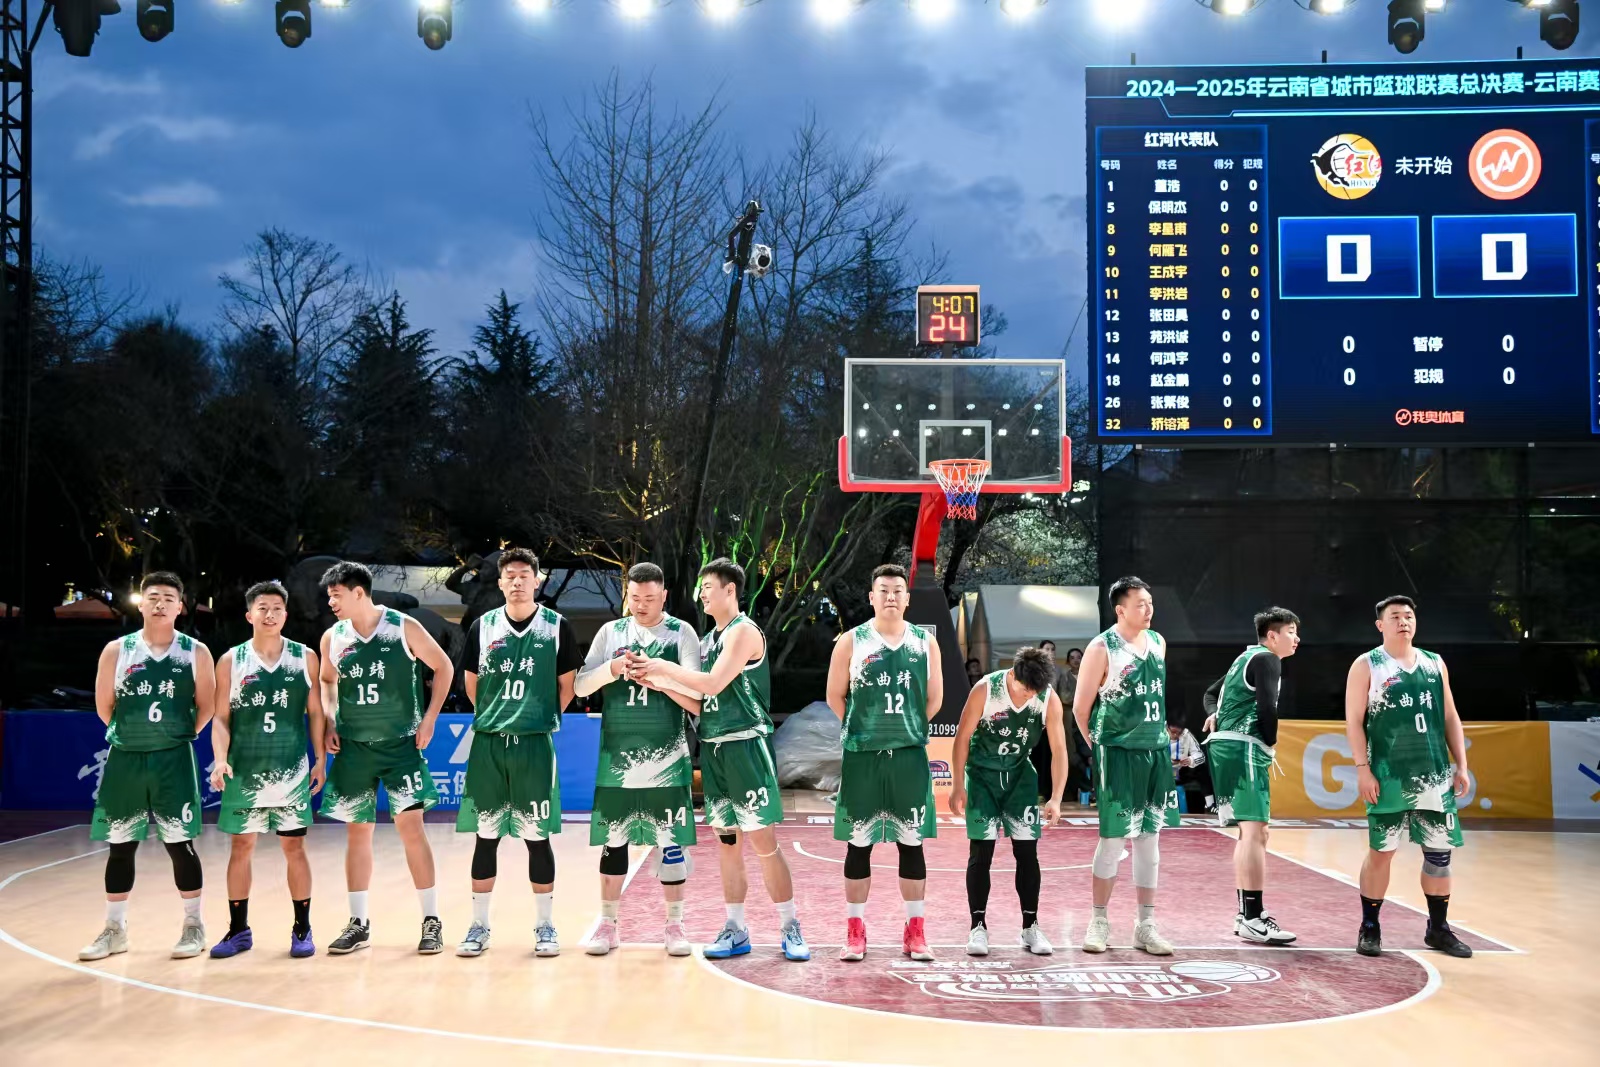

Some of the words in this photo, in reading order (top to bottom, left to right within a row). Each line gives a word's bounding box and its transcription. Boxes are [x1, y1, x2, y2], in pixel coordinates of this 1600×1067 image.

[1145, 132, 1218, 147] 红河代表队
[1101, 160, 1120, 170] 号码
[1157, 160, 1177, 169] 姓名
[1214, 159, 1234, 169] 得分
[1243, 159, 1263, 169] 犯规
[1396, 156, 1452, 175] 未开始
[1108, 181, 1113, 191] 1
[1220, 180, 1228, 190] 0
[1249, 180, 1257, 190] 0
[1107, 202, 1114, 213] 5
[1149, 201, 1186, 213] 保明杰
[1221, 201, 1228, 212] 0
[1250, 201, 1257, 212] 0
[1107, 224, 1115, 234] 8
[1221, 223, 1229, 233] 0
[1250, 223, 1258, 233] 0
[1108, 245, 1115, 256] 9
[1222, 245, 1229, 255] 0
[1251, 244, 1258, 254] 0
[1105, 267, 1119, 277] 10
[1150, 265, 1187, 278] 王成宇
[1222, 266, 1229, 276] 0
[1251, 266, 1258, 276] 0
[1106, 289, 1117, 299] 11
[1222, 288, 1229, 298] 0
[1251, 288, 1258, 298] 0
[932, 296, 974, 314] 4:07
[1106, 310, 1119, 320] 12
[1222, 309, 1230, 320] 0
[1251, 309, 1259, 320] 0
[929, 314, 965, 342] 24
[1106, 332, 1119, 342] 13
[1223, 331, 1230, 342] 0
[1252, 331, 1259, 341] 0
[1343, 336, 1354, 353] 0
[1413, 337, 1443, 352] 暂停
[1502, 335, 1514, 352] 0
[1106, 353, 1120, 364] 14
[1223, 352, 1231, 363] 0
[1252, 352, 1260, 363] 0
[1106, 375, 1120, 386] 18
[1223, 374, 1231, 385] 0
[1252, 374, 1260, 385] 0
[1344, 368, 1355, 385] 0
[1414, 369, 1443, 383] 犯规
[1503, 367, 1515, 384] 0
[1105, 397, 1120, 408] 26
[1224, 396, 1231, 407] 0
[1253, 396, 1260, 407] 0
[1106, 419, 1120, 429] 32
[1224, 418, 1231, 429] 0
[1253, 418, 1261, 428] 0
[348, 661, 386, 680] 曲靖
[500, 656, 535, 676] 曲靖
[876, 669, 912, 689] 曲靖
[1134, 677, 1163, 698] 曲靖
[136, 679, 176, 699] 曲靖
[251, 688, 289, 709] 曲靖
[356, 684, 379, 705] 15
[501, 679, 525, 700] 10
[626, 685, 648, 707] 14
[703, 694, 720, 713] 23
[884, 693, 905, 714] 12
[1399, 689, 1433, 710] 曲靖
[148, 701, 163, 723] 6
[1143, 701, 1160, 722] 13
[262, 712, 276, 734] 5
[1414, 712, 1427, 734] 0
[998, 726, 1029, 746] 曲靖
[402, 770, 424, 795] 15
[745, 786, 769, 811] 23
[181, 801, 193, 824] 6
[529, 799, 550, 821] 10
[664, 806, 687, 828] 14
[1445, 812, 1456, 831] 0
